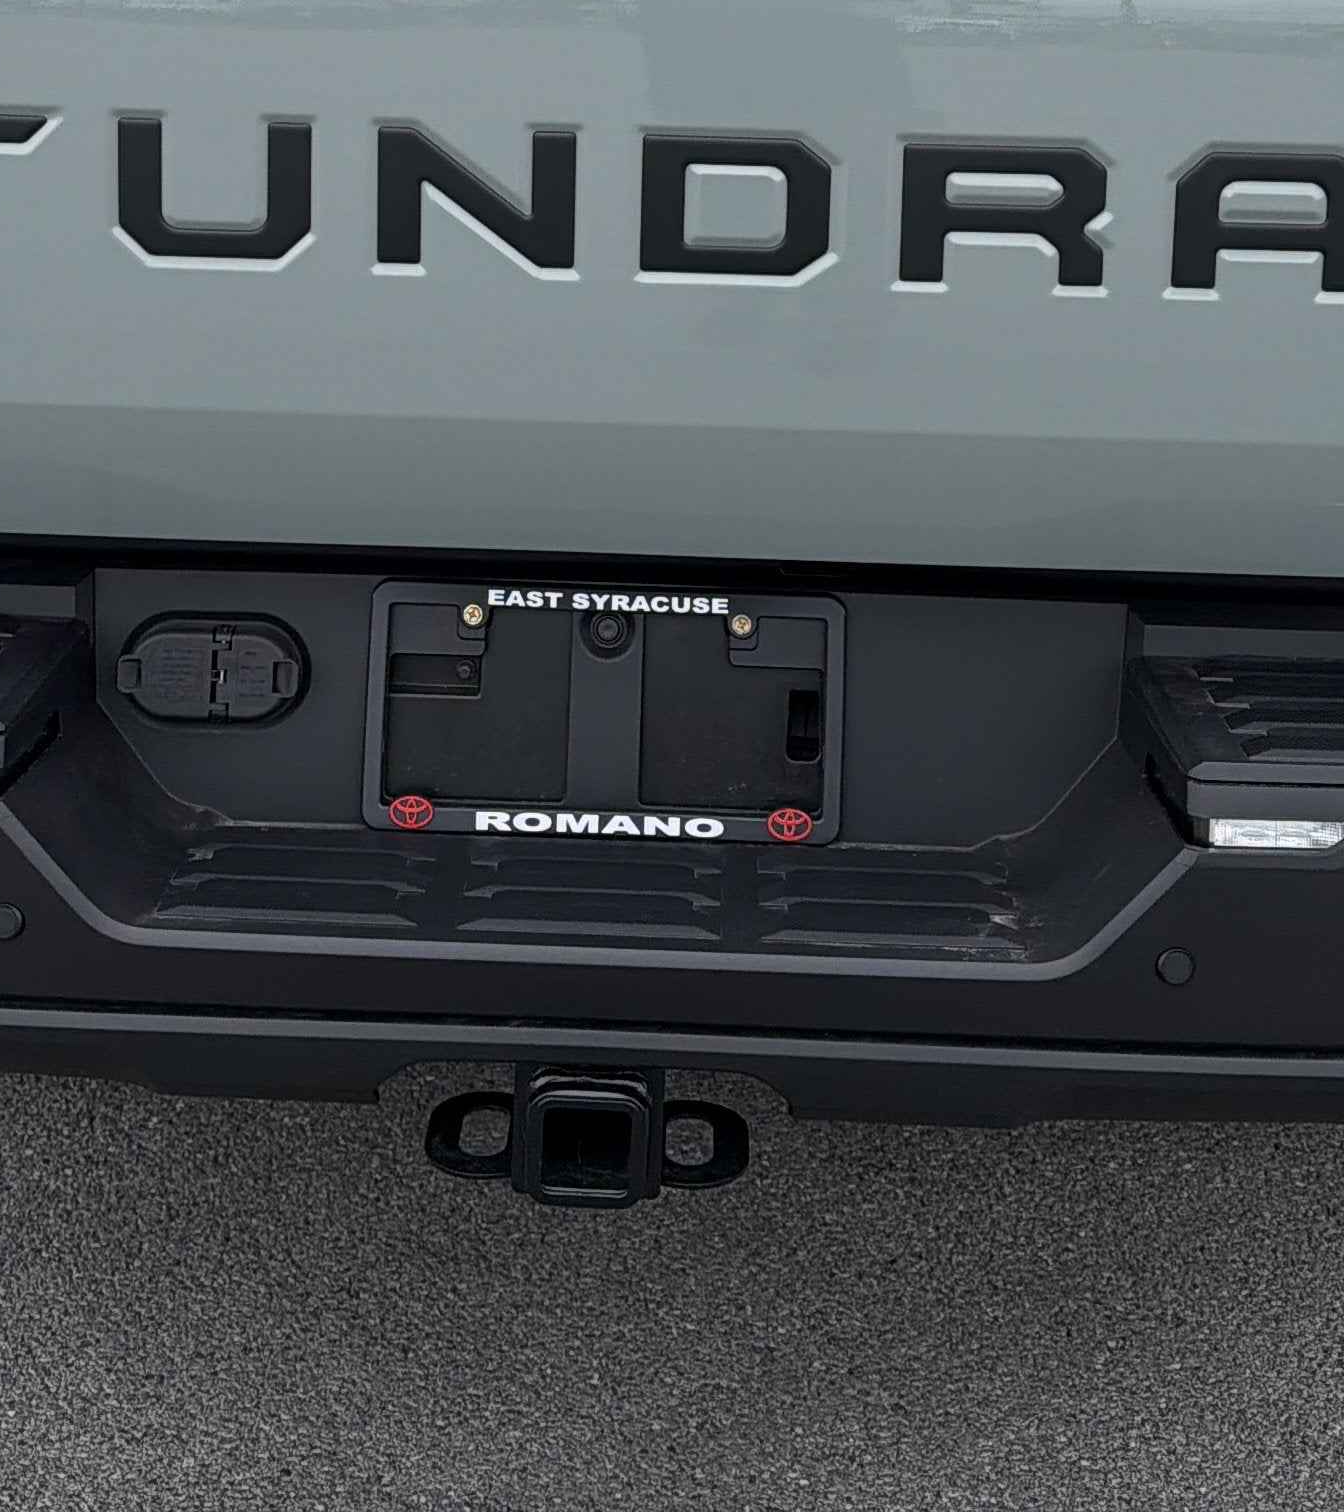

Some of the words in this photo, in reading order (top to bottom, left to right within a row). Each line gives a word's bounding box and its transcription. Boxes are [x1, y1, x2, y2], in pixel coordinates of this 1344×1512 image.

[487, 589, 564, 609] EAST
[571, 592, 730, 616] SYRACUSE
[474, 810, 725, 839] ROMANO
